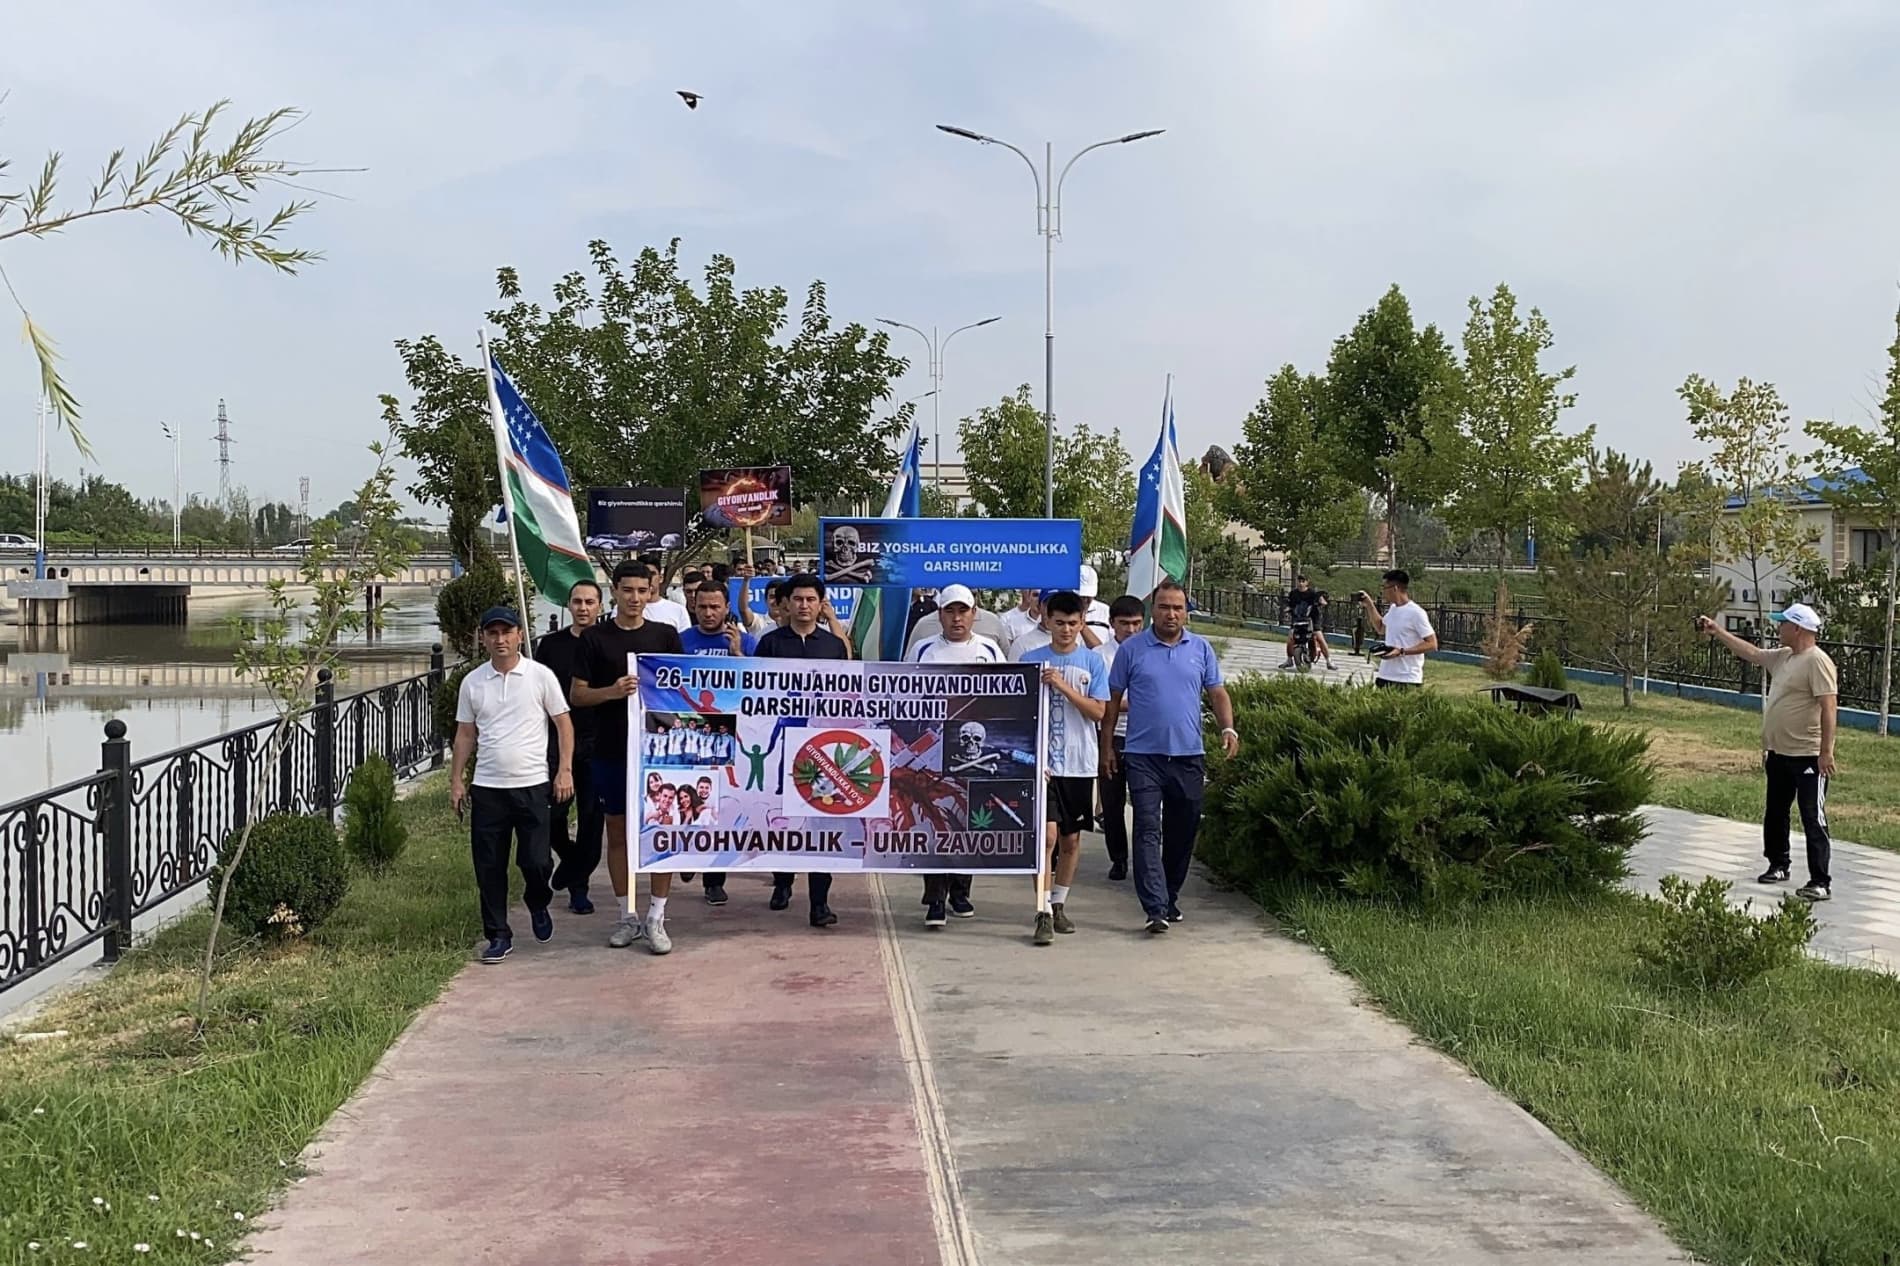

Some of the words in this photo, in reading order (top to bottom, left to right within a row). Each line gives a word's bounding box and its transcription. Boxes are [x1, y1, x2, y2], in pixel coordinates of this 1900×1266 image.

[717, 490, 778, 506] GIYOHVANDLIK
[857, 542, 880, 553] BIZ
[883, 543, 946, 554] YOSHLAR
[950, 543, 1069, 554] GIYOHVANDLIKKA
[923, 561, 1002, 573] QARSHIMIZ!
[657, 668, 736, 689] 26-IYUN
[742, 671, 862, 693] BUTUNJAHON
[868, 674, 1026, 695] GIYOHVANDLIKKA
[741, 697, 810, 717] QARSHI
[815, 699, 892, 719] KURASH
[896, 700, 947, 720] KUNI!
[806, 744, 851, 793] GIYOHVANDLIKKA
[653, 830, 843, 852] GIYOHVANDLIK
[873, 832, 928, 853] UMR
[935, 833, 1023, 854] ZAVOLI!
